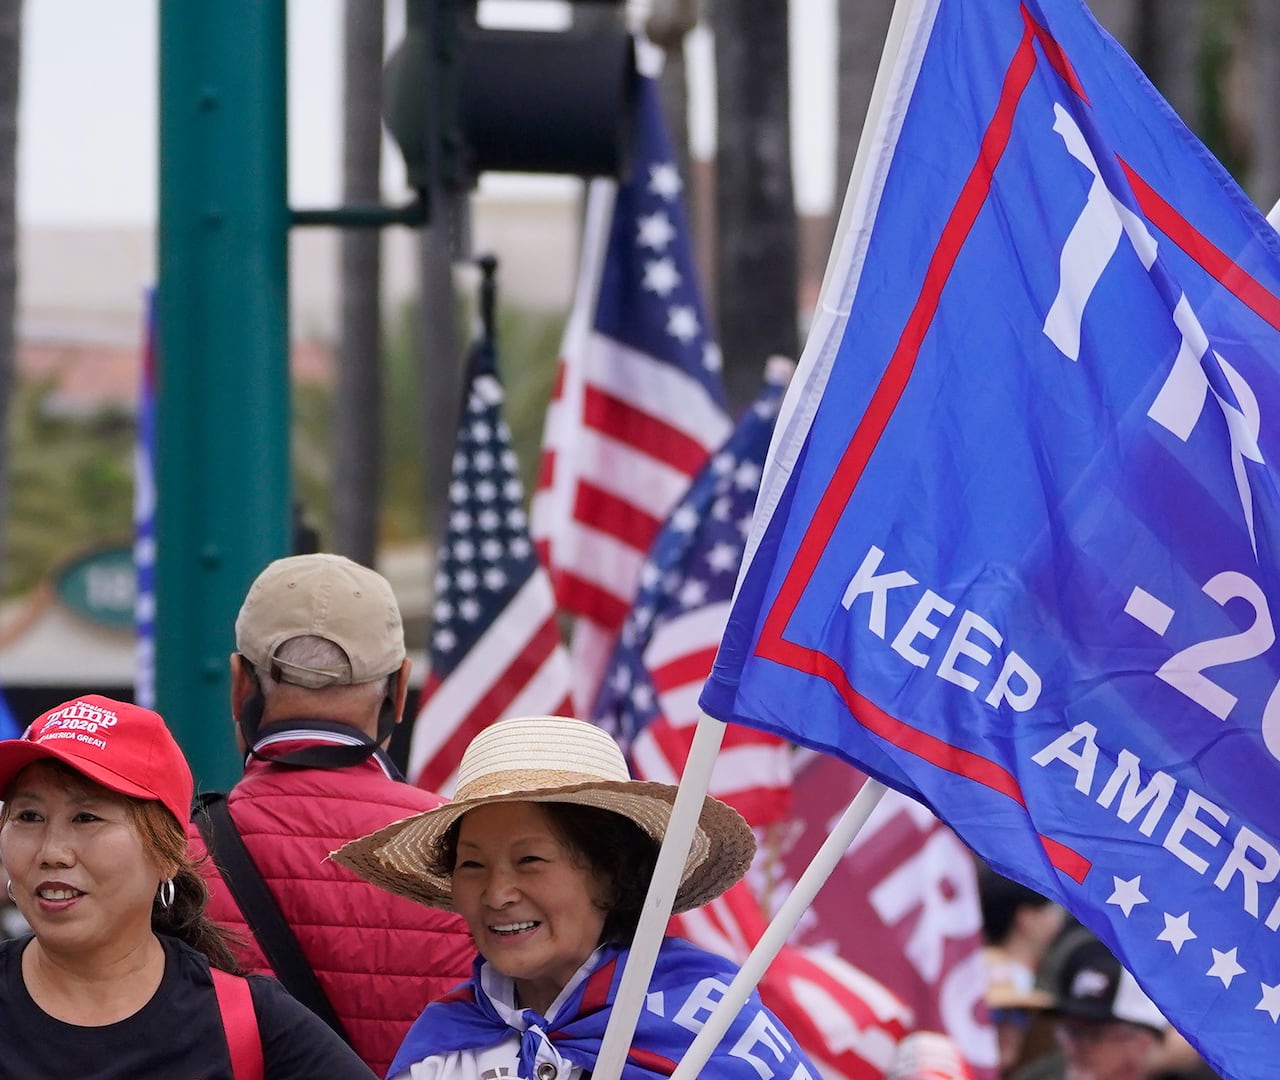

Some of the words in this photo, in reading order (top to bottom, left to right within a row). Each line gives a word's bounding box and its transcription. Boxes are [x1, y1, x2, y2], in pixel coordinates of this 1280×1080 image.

[841, 544, 1042, 712] KEEP
[59, 719, 98, 733] 2020
[77, 733, 107, 750] GREAT!
